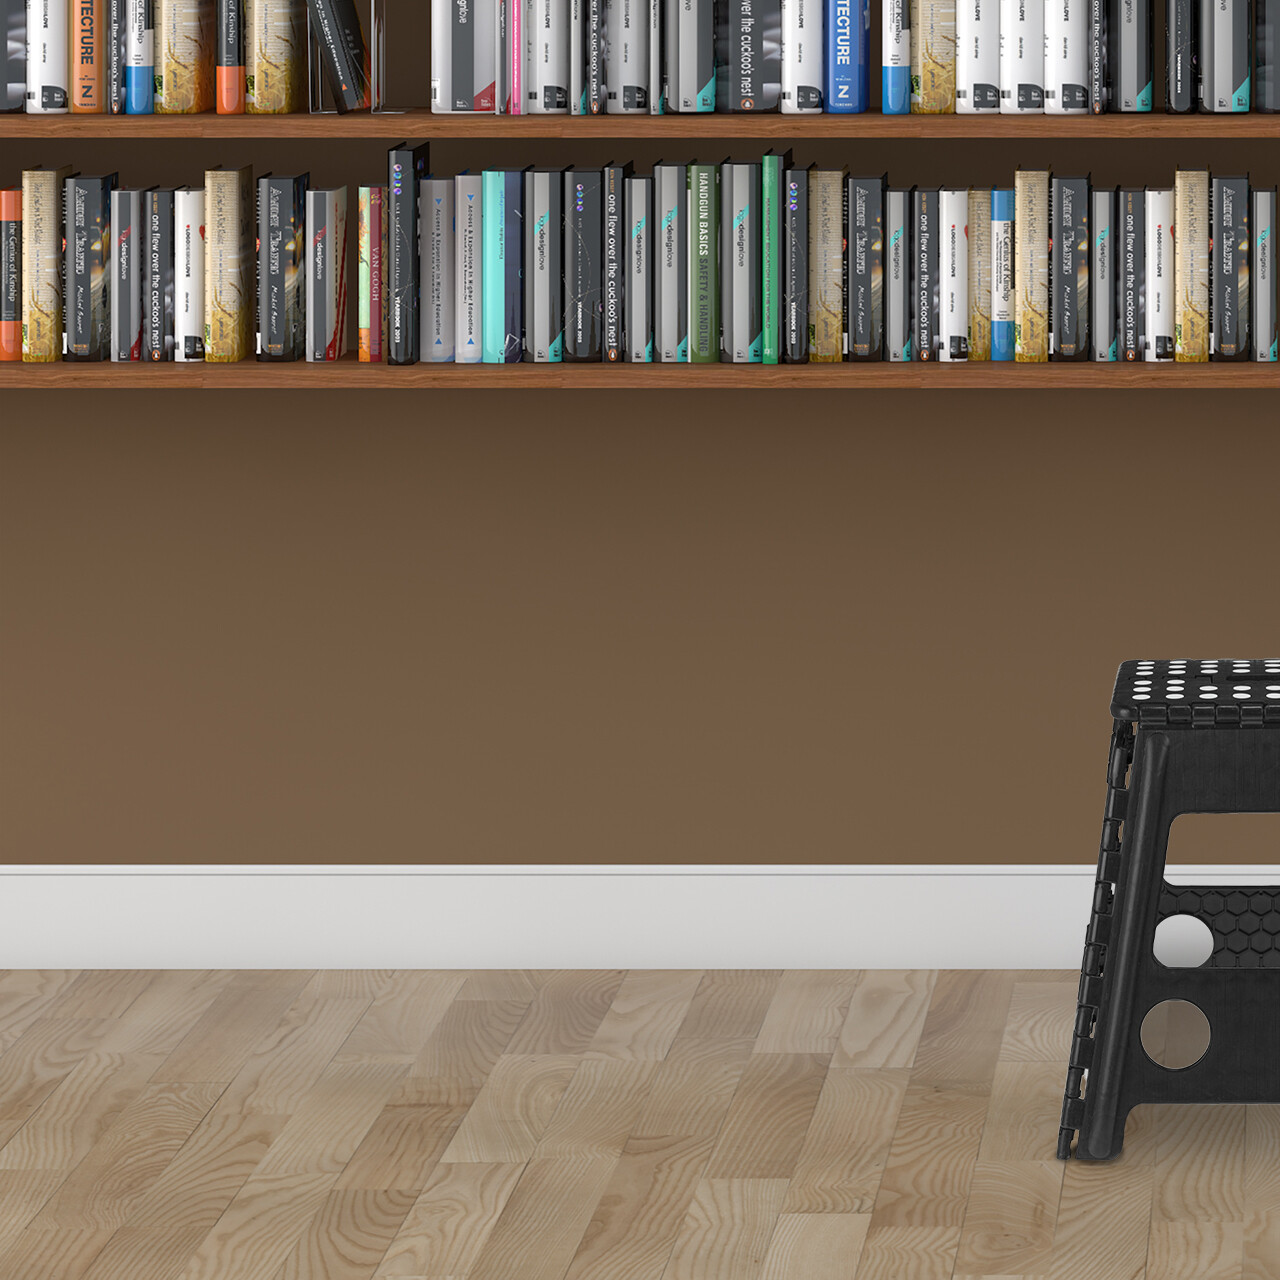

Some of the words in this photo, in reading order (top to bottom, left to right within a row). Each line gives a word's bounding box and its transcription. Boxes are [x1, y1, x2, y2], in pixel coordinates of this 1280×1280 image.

[228, 0, 236, 9] of
[227, 12, 236, 44] Kinship
[741, 18, 754, 32] the
[741, 77, 753, 96] nest
[699, 173, 708, 219] HANDGUN
[608, 215, 617, 235] flew
[699, 221, 708, 256] BASICS
[608, 263, 617, 278] the
[699, 258, 708, 291] SAFETY
[608, 326, 616, 346] nest
[699, 304, 708, 352] HANDLING
